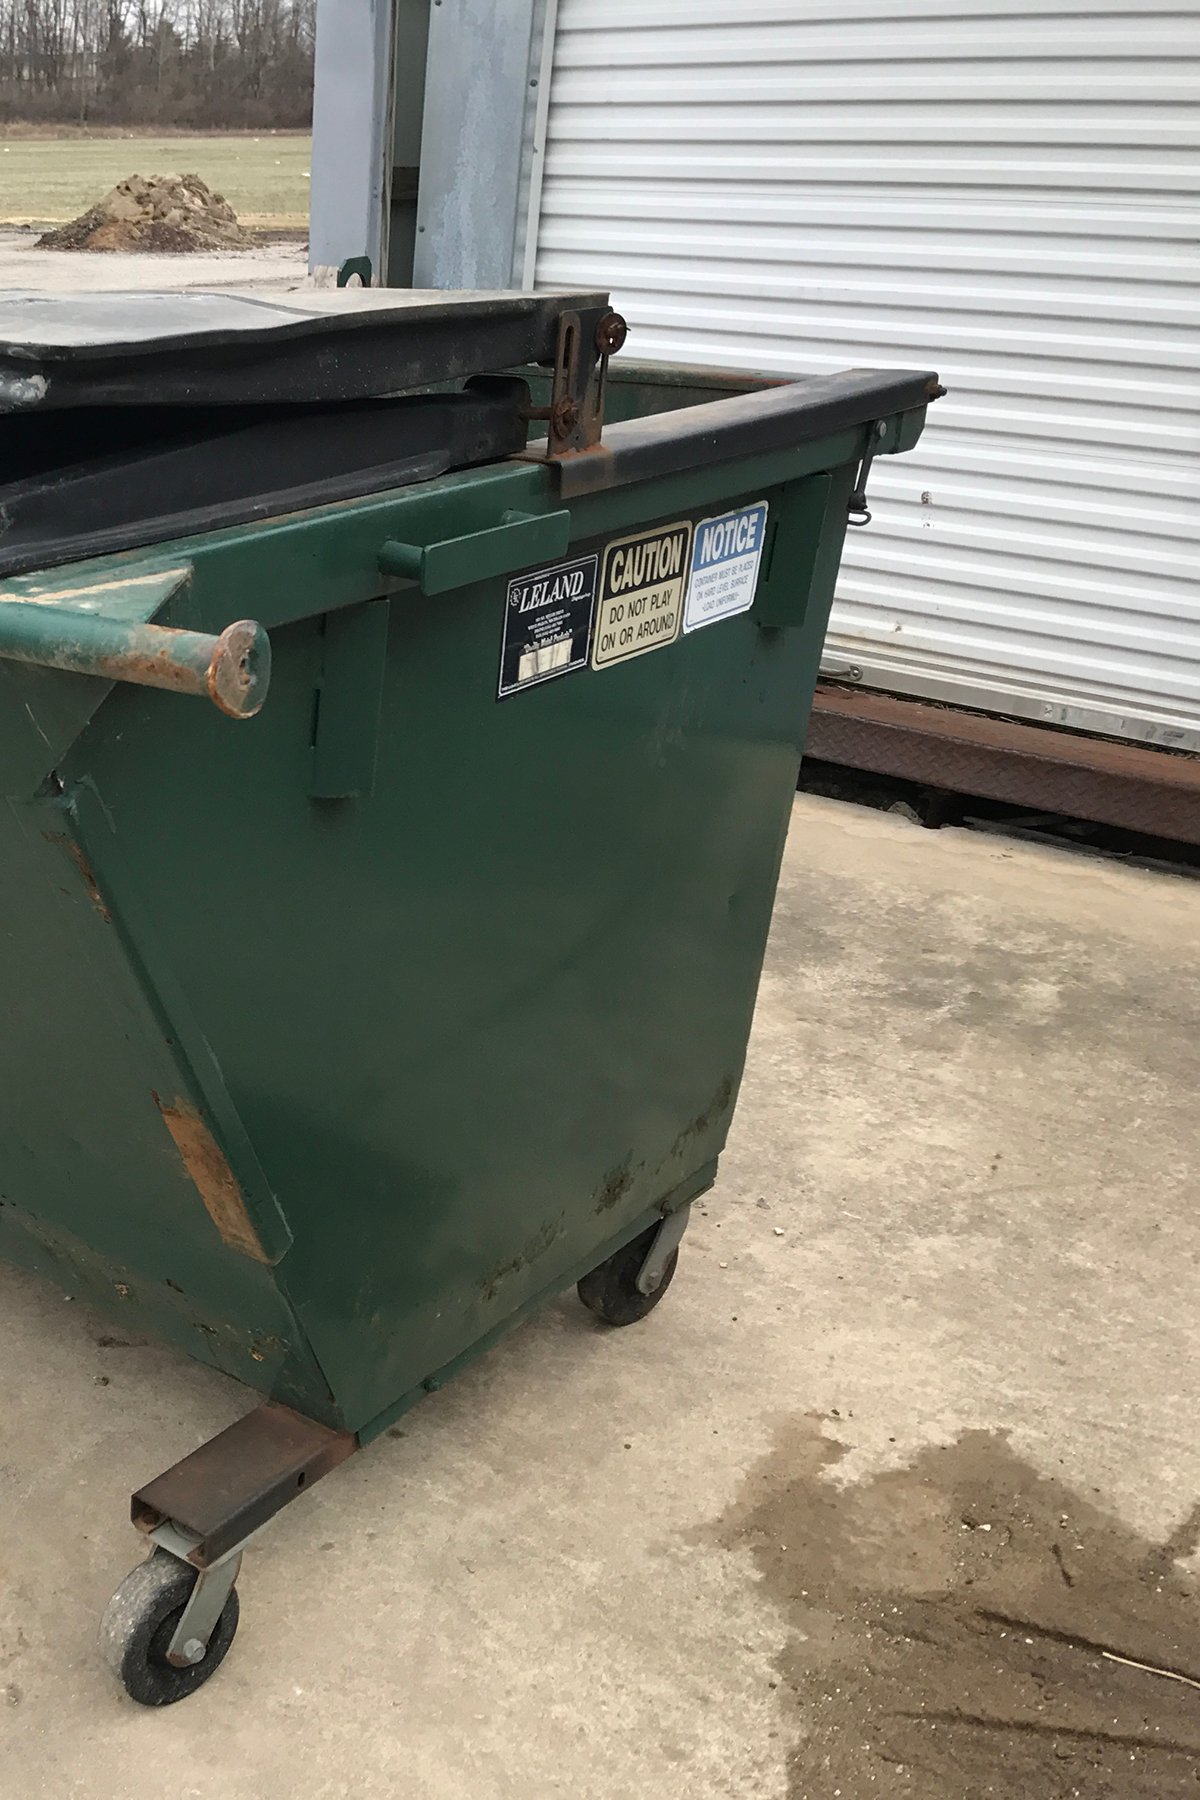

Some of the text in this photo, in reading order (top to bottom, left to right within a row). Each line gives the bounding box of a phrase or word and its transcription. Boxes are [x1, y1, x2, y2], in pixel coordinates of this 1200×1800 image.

[700, 513, 759, 565] NOTICE
[610, 534, 684, 593] CAUTION
[518, 571, 584, 613] LELAND
[609, 588, 673, 625] DO NOT PLAY
[601, 612, 675, 652] ON OR AROUND
